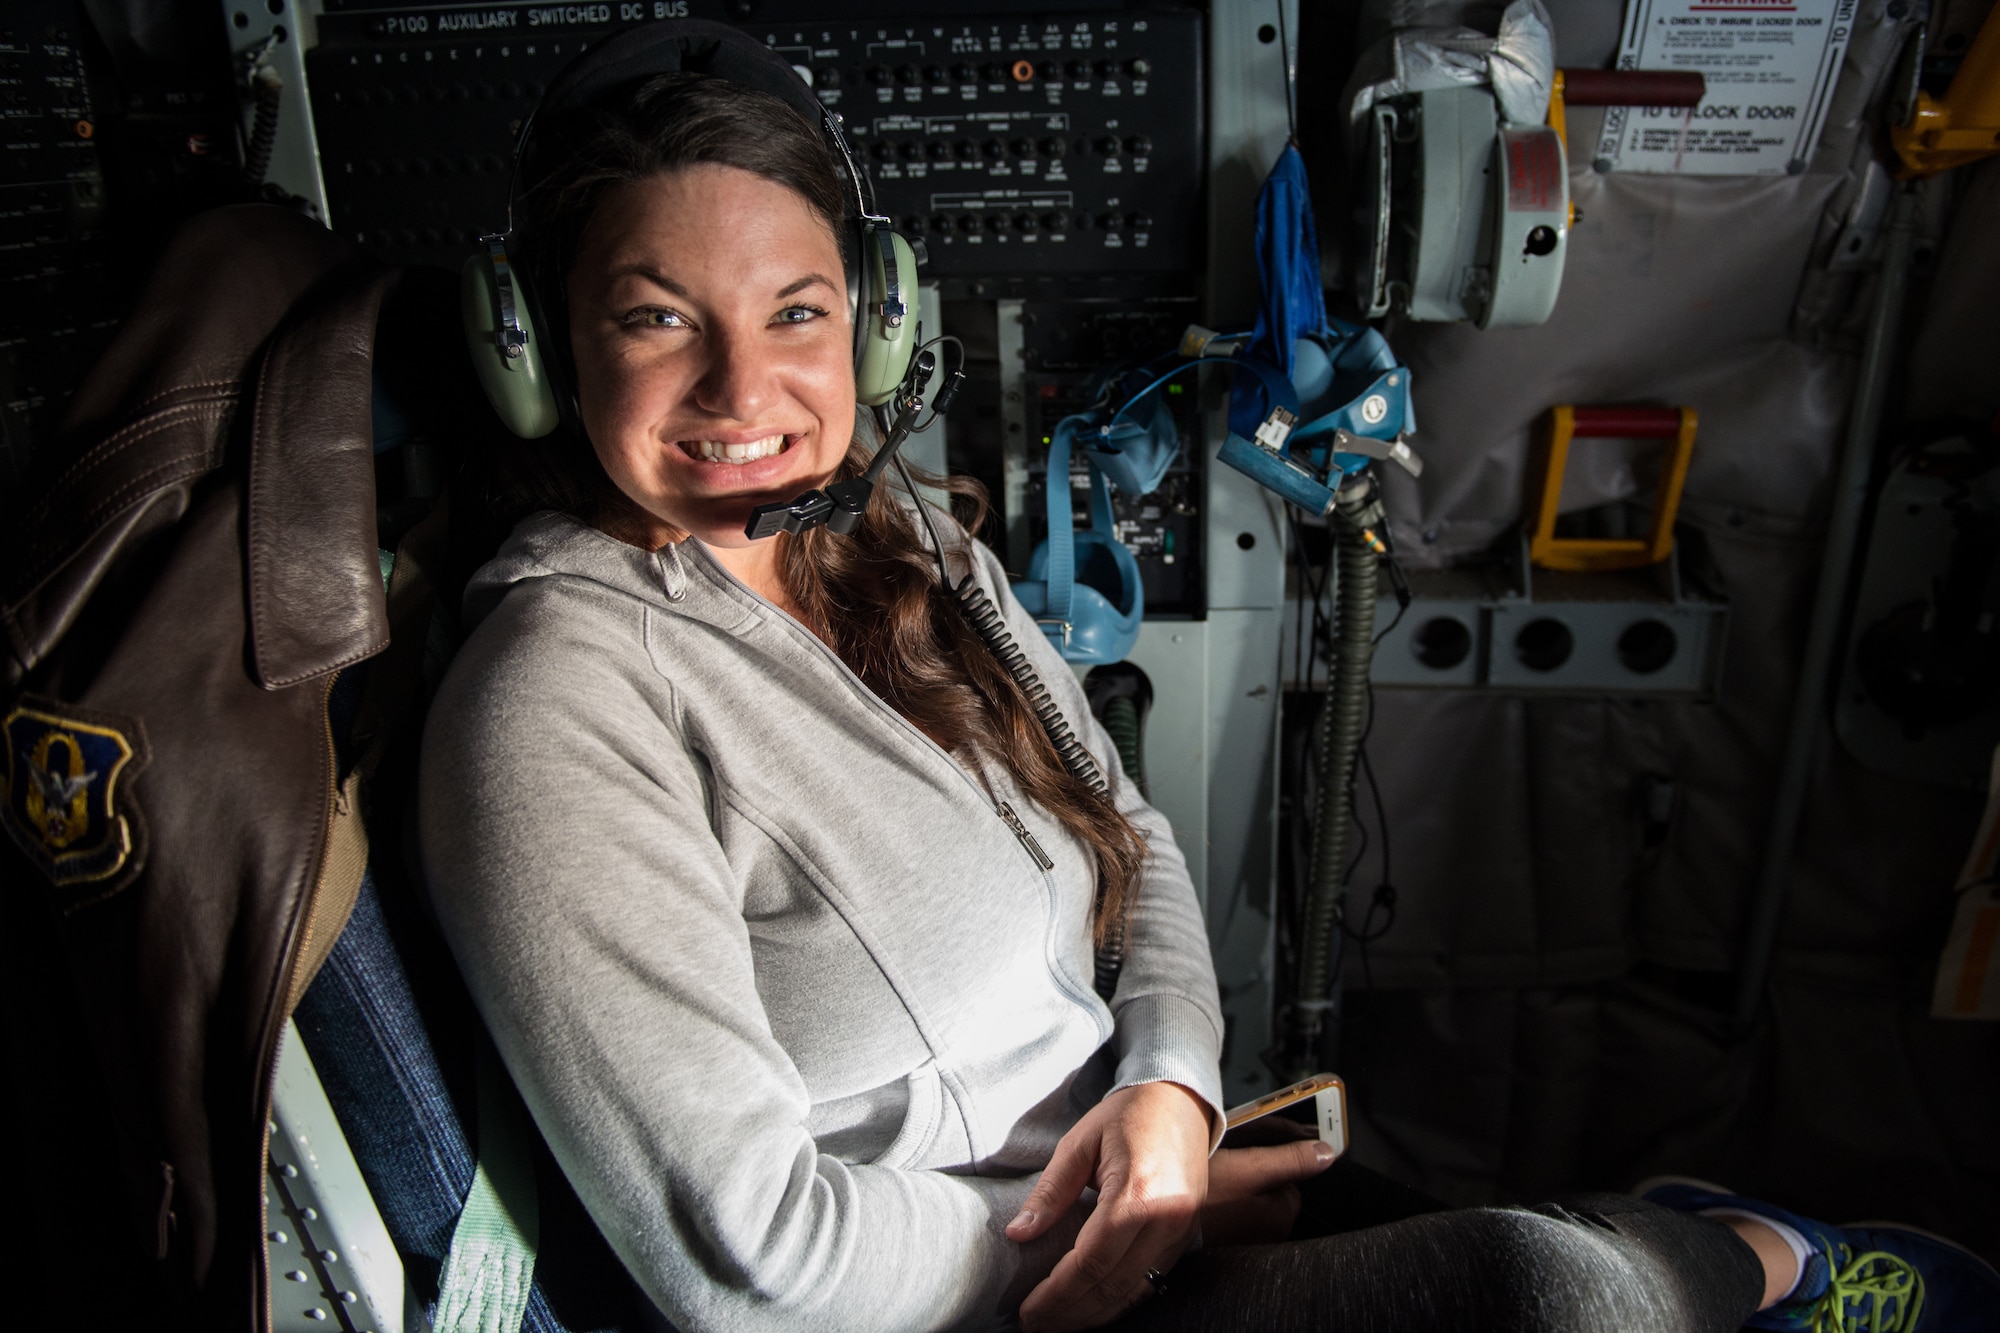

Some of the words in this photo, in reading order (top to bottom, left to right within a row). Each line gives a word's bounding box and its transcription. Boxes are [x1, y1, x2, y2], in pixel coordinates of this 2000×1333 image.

[386, 15, 430, 34] P100
[438, 10, 518, 32] AUXILIARY
[527, 4, 612, 27] SWITCHED
[620, 2, 645, 21] DC
[653, 0, 690, 19] BUS
[1837, 0, 1854, 21] UN
[1831, 26, 1848, 44] TO
[1747, 105, 1797, 119] DOOR
